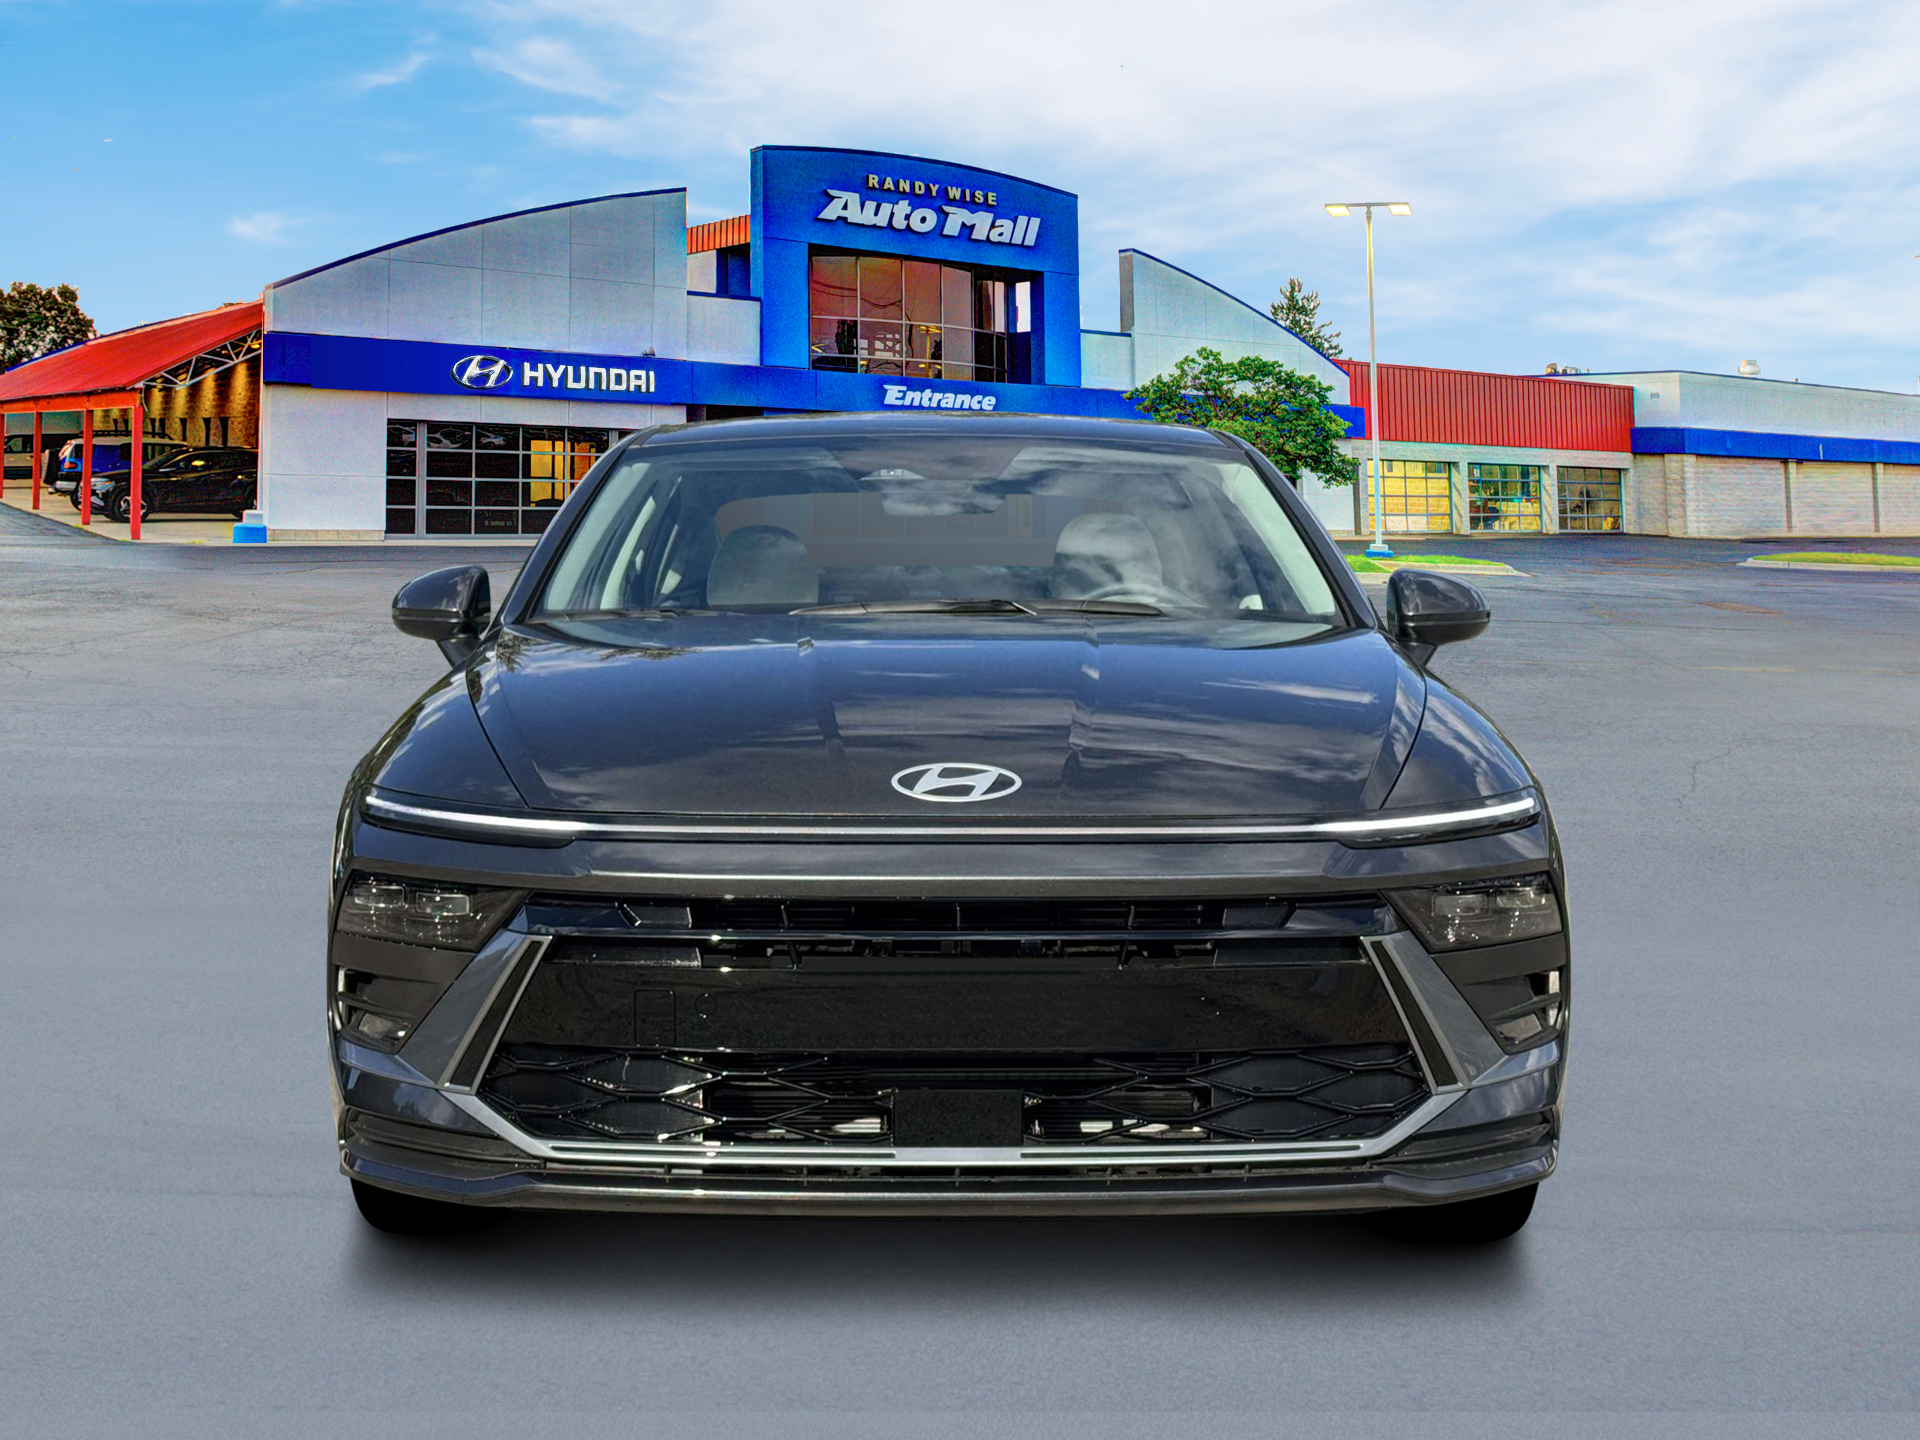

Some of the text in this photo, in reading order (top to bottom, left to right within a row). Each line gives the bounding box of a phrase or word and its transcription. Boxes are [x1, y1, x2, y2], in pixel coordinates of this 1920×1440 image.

[867, 173, 998, 205] RANDY WISE
[817, 188, 1041, 247] Auto Mall
[521, 361, 656, 393] HYUNDAI
[883, 384, 997, 411] Entrance
